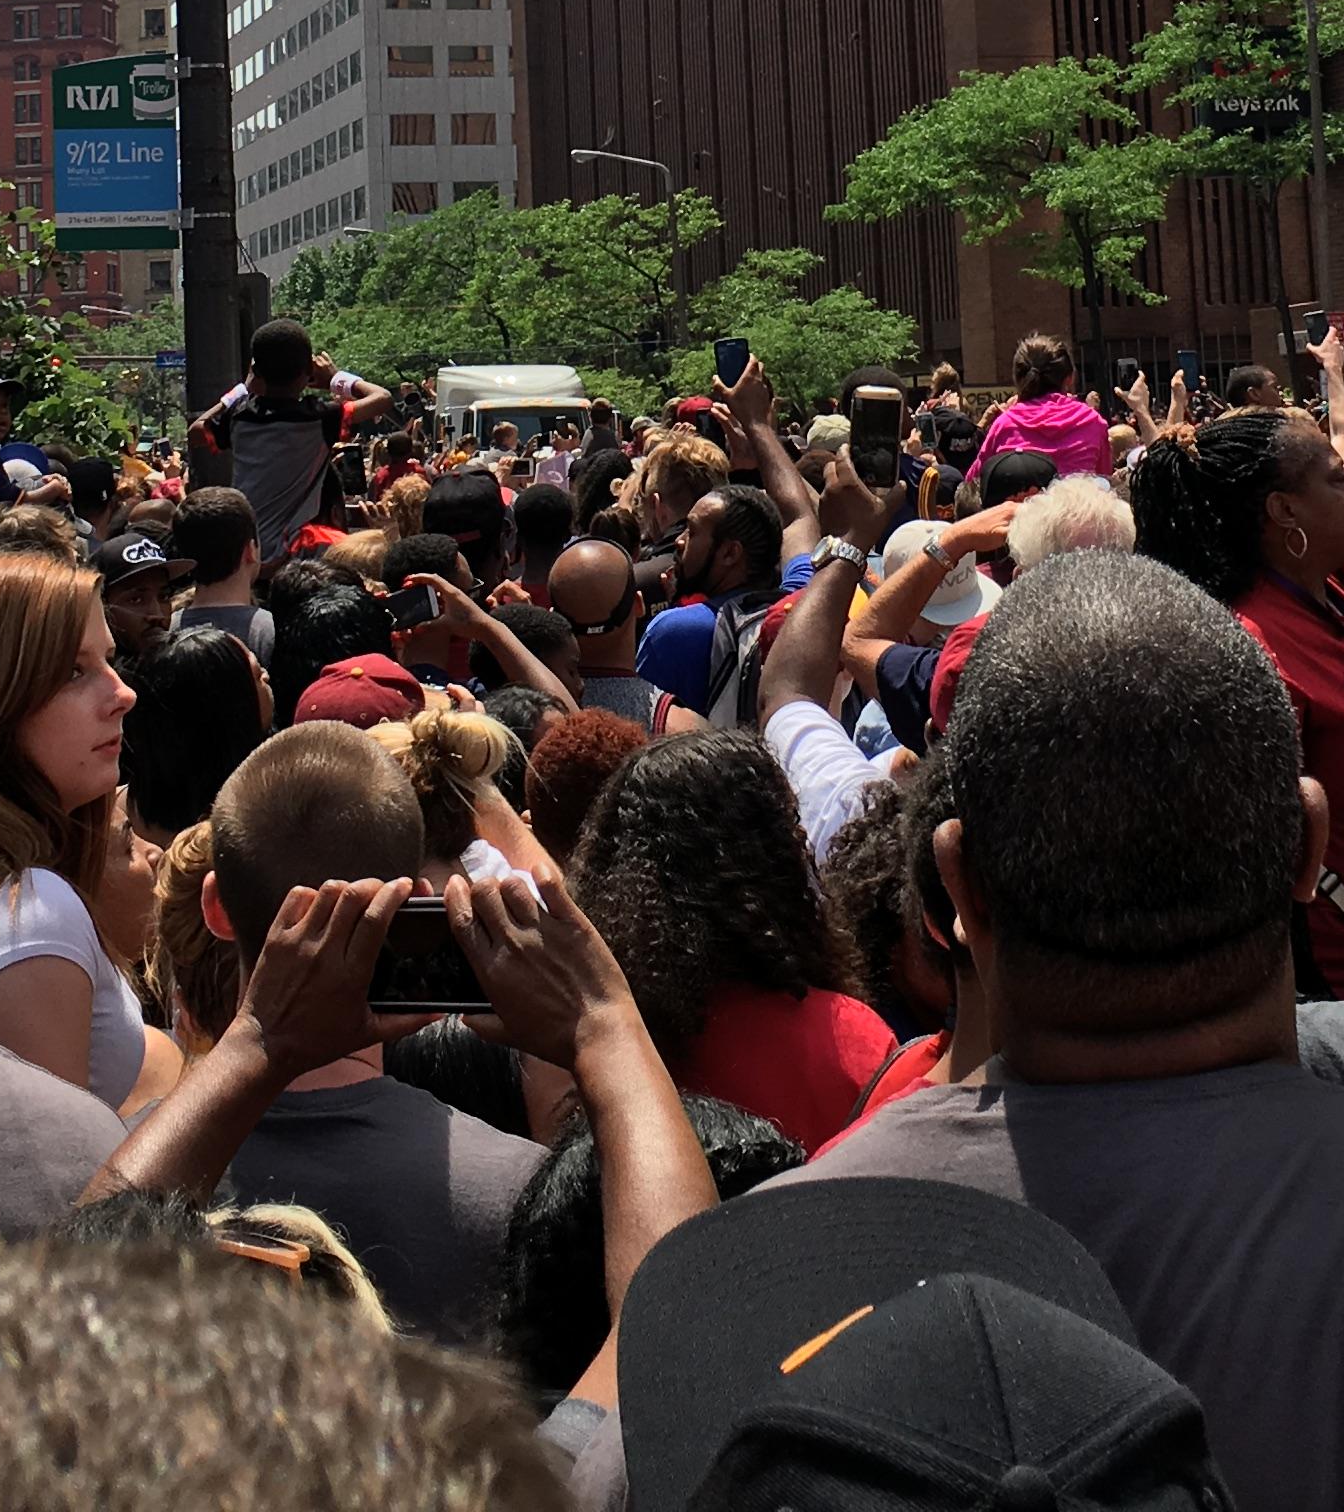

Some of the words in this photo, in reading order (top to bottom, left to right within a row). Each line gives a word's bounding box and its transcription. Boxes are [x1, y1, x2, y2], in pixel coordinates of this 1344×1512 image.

[66, 85, 119, 111] RTA
[138, 80, 170, 97] Trolley
[66, 140, 110, 166] 9/12
[116, 142, 164, 164] Line
